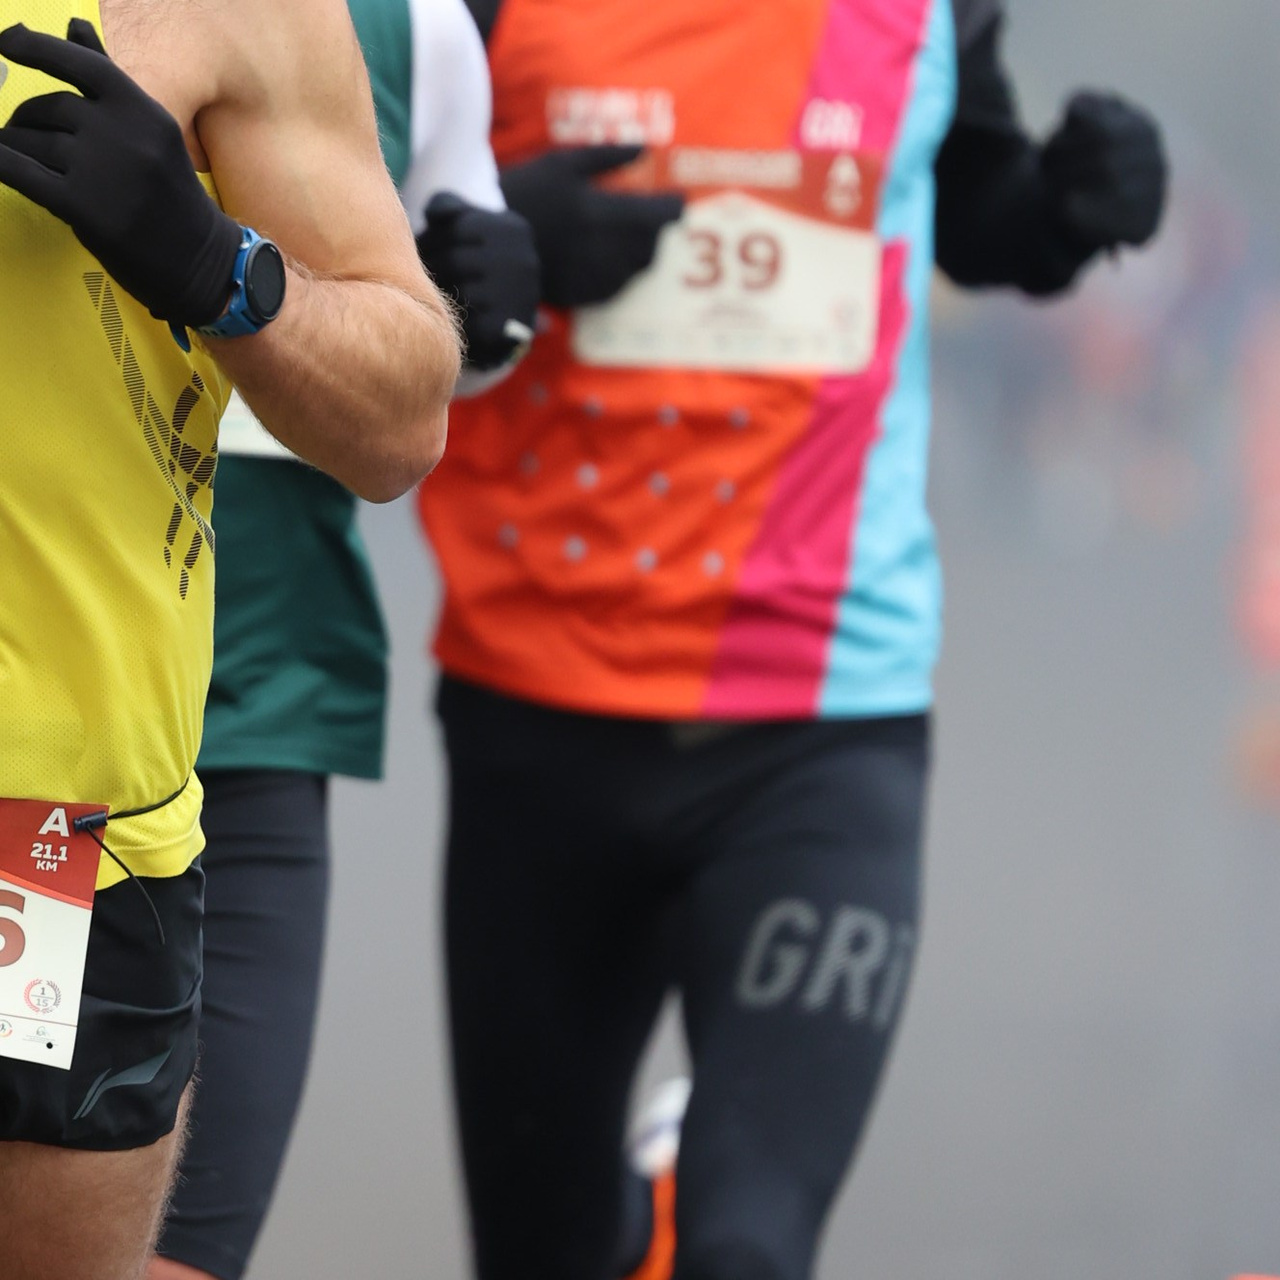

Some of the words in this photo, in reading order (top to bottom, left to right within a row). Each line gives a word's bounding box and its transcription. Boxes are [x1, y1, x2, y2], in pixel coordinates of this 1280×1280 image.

[681, 231, 783, 291] 39
[30, 842, 68, 862] 21.1
[40, 987, 46, 996] 1
[36, 998, 49, 1007] 15
